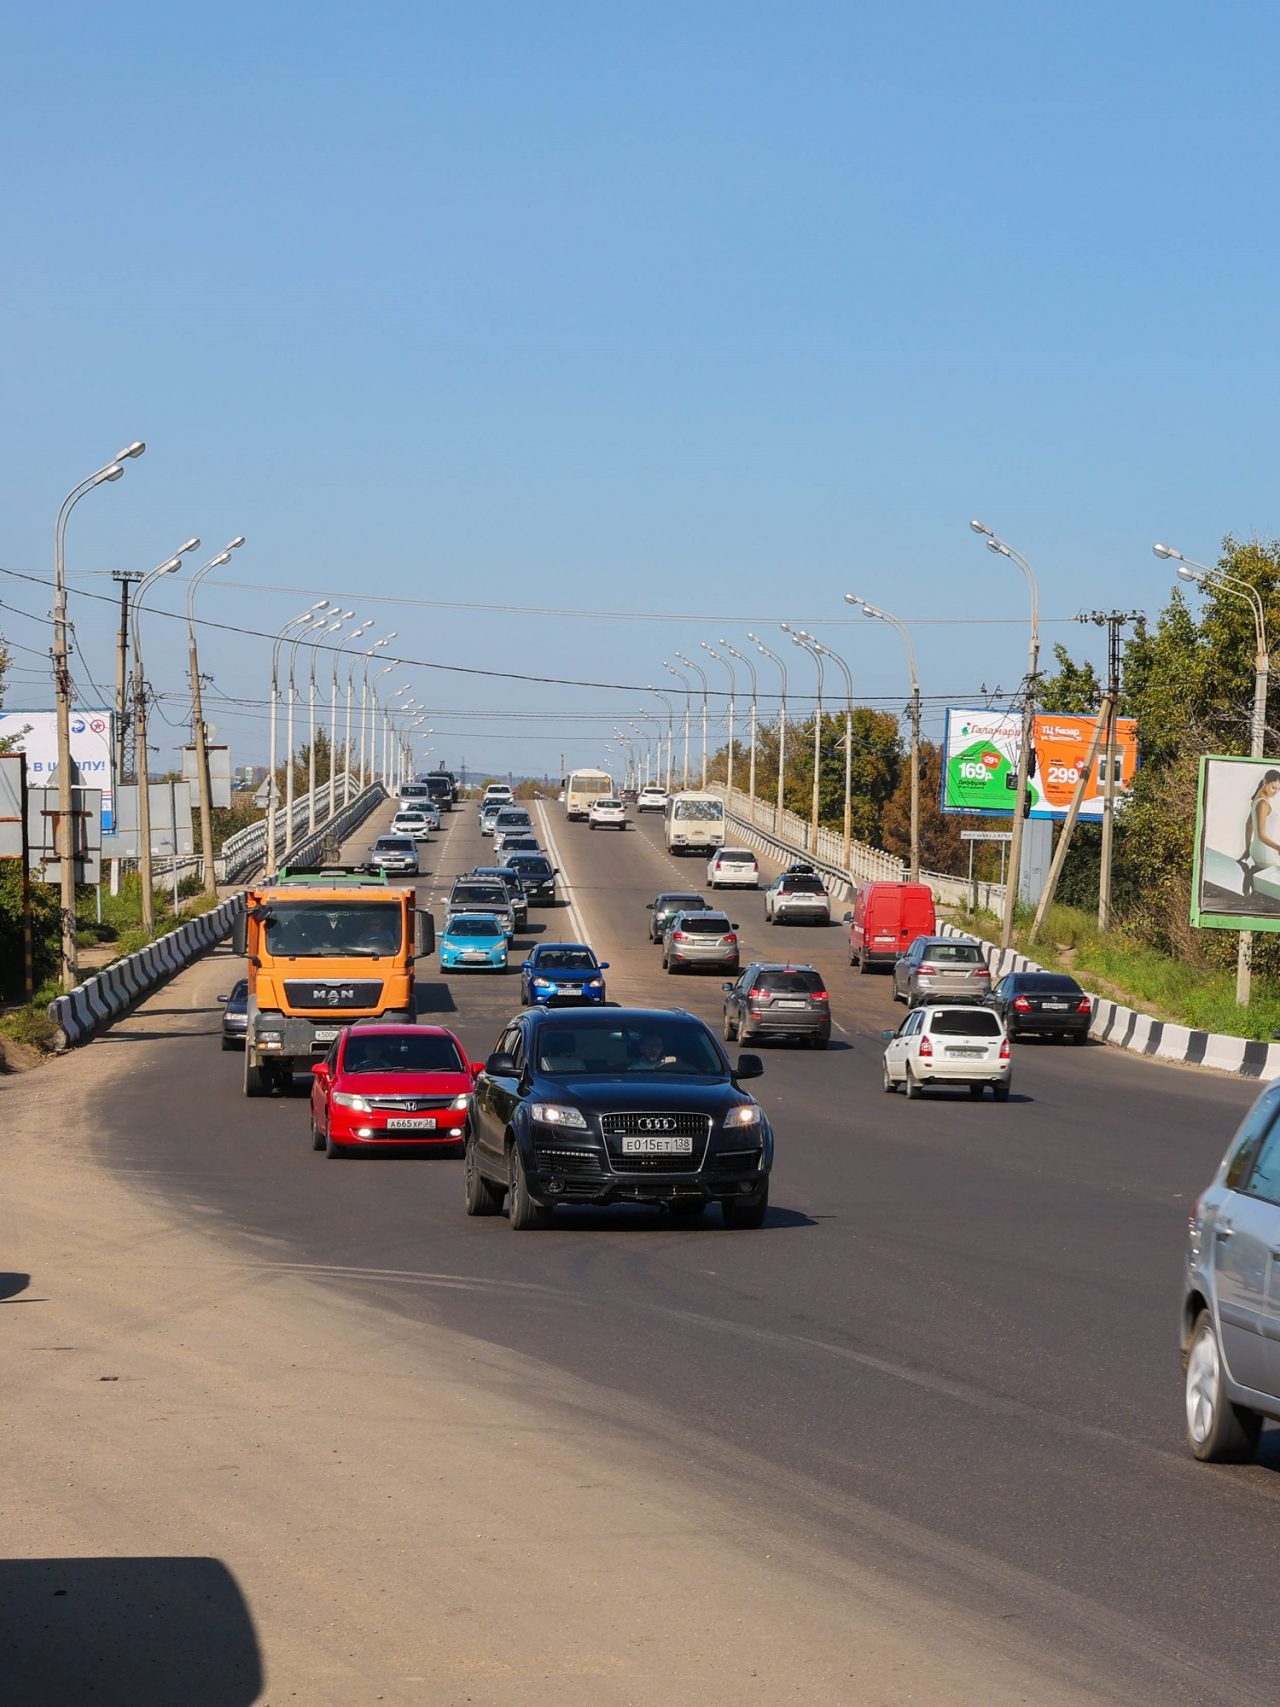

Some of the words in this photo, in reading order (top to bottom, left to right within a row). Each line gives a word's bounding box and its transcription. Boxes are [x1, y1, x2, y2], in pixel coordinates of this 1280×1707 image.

[33, 762, 43, 772] В
[48, 761, 106, 772] ШЛУ!
[1047, 767, 1078, 784] 299
[313, 989, 354, 999] MAN
[390, 1119, 423, 1128] А665ХР
[626, 1139, 671, 1151] Е015ЕТ
[674, 1138, 690, 1149] 138
